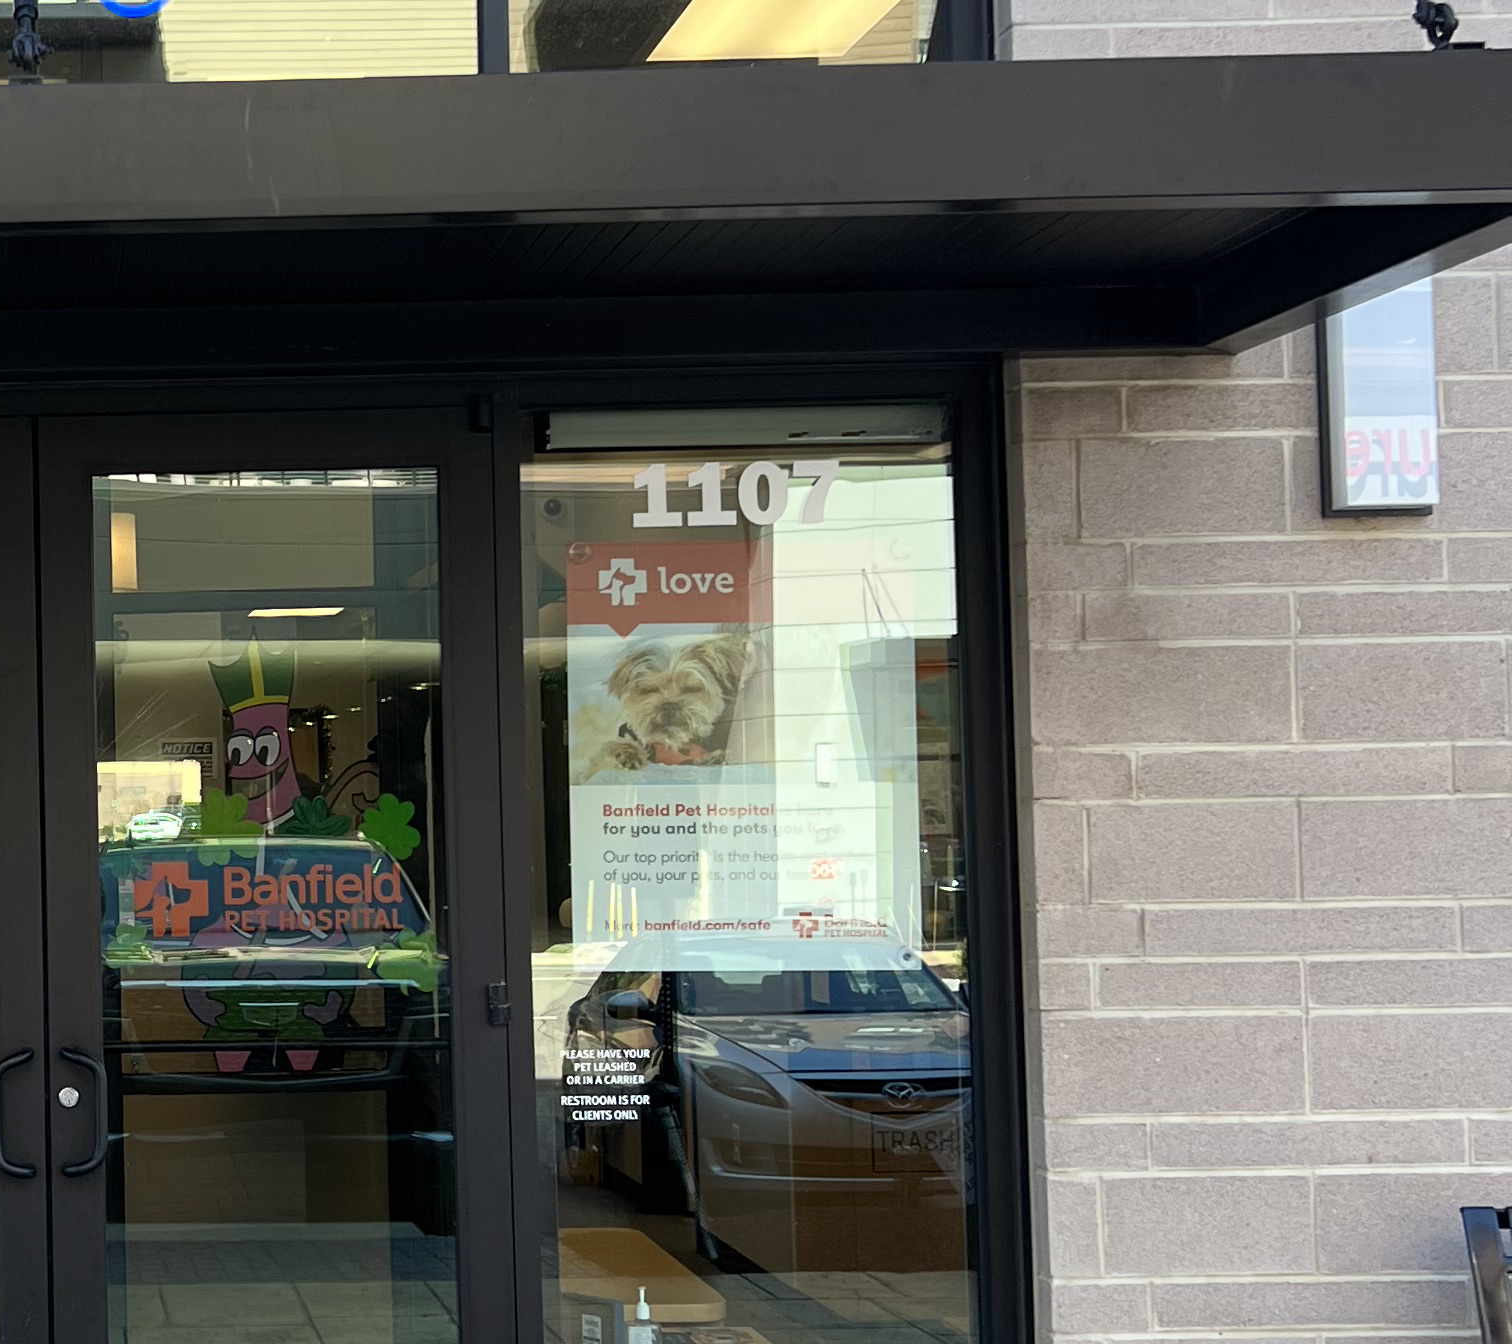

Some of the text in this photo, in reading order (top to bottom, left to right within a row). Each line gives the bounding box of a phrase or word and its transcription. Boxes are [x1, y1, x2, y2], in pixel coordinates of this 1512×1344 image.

[633, 460, 839, 527] 1107
[657, 566, 734, 594] love
[164, 743, 211, 754] NOTICE
[602, 804, 670, 817] Banfield
[675, 804, 701, 817] Pet
[706, 804, 775, 819] Hospital
[603, 823, 627, 835] for
[631, 825, 661, 838] you
[665, 823, 697, 835] and
[701, 823, 728, 835] the
[733, 824, 768, 838] pets
[774, 824, 804, 838] you
[603, 851, 630, 863] Our
[634, 852, 665, 866] top
[714, 851, 724, 863] is
[728, 851, 750, 863] the
[603, 869, 619, 881] of
[622, 871, 652, 884] you,
[656, 871, 686, 884] your
[728, 869, 755, 881] and
[224, 865, 404, 906] Banfield
[226, 909, 405, 931] PET HOSPITAL
[644, 919, 772, 932] banfield.com/safe
[842, 929, 888, 938] HOSPITAL
[560, 1048, 651, 1059] PLEASE HAVE YOUR
[574, 1062, 637, 1072] PET LEASHED
[566, 1074, 645, 1085] OR IN A CARRIER
[561, 1095, 651, 1106] RESTROOM IS FOR
[572, 1110, 639, 1121] CLIENTS ONLY
[876, 1131, 955, 1153] TRASH
